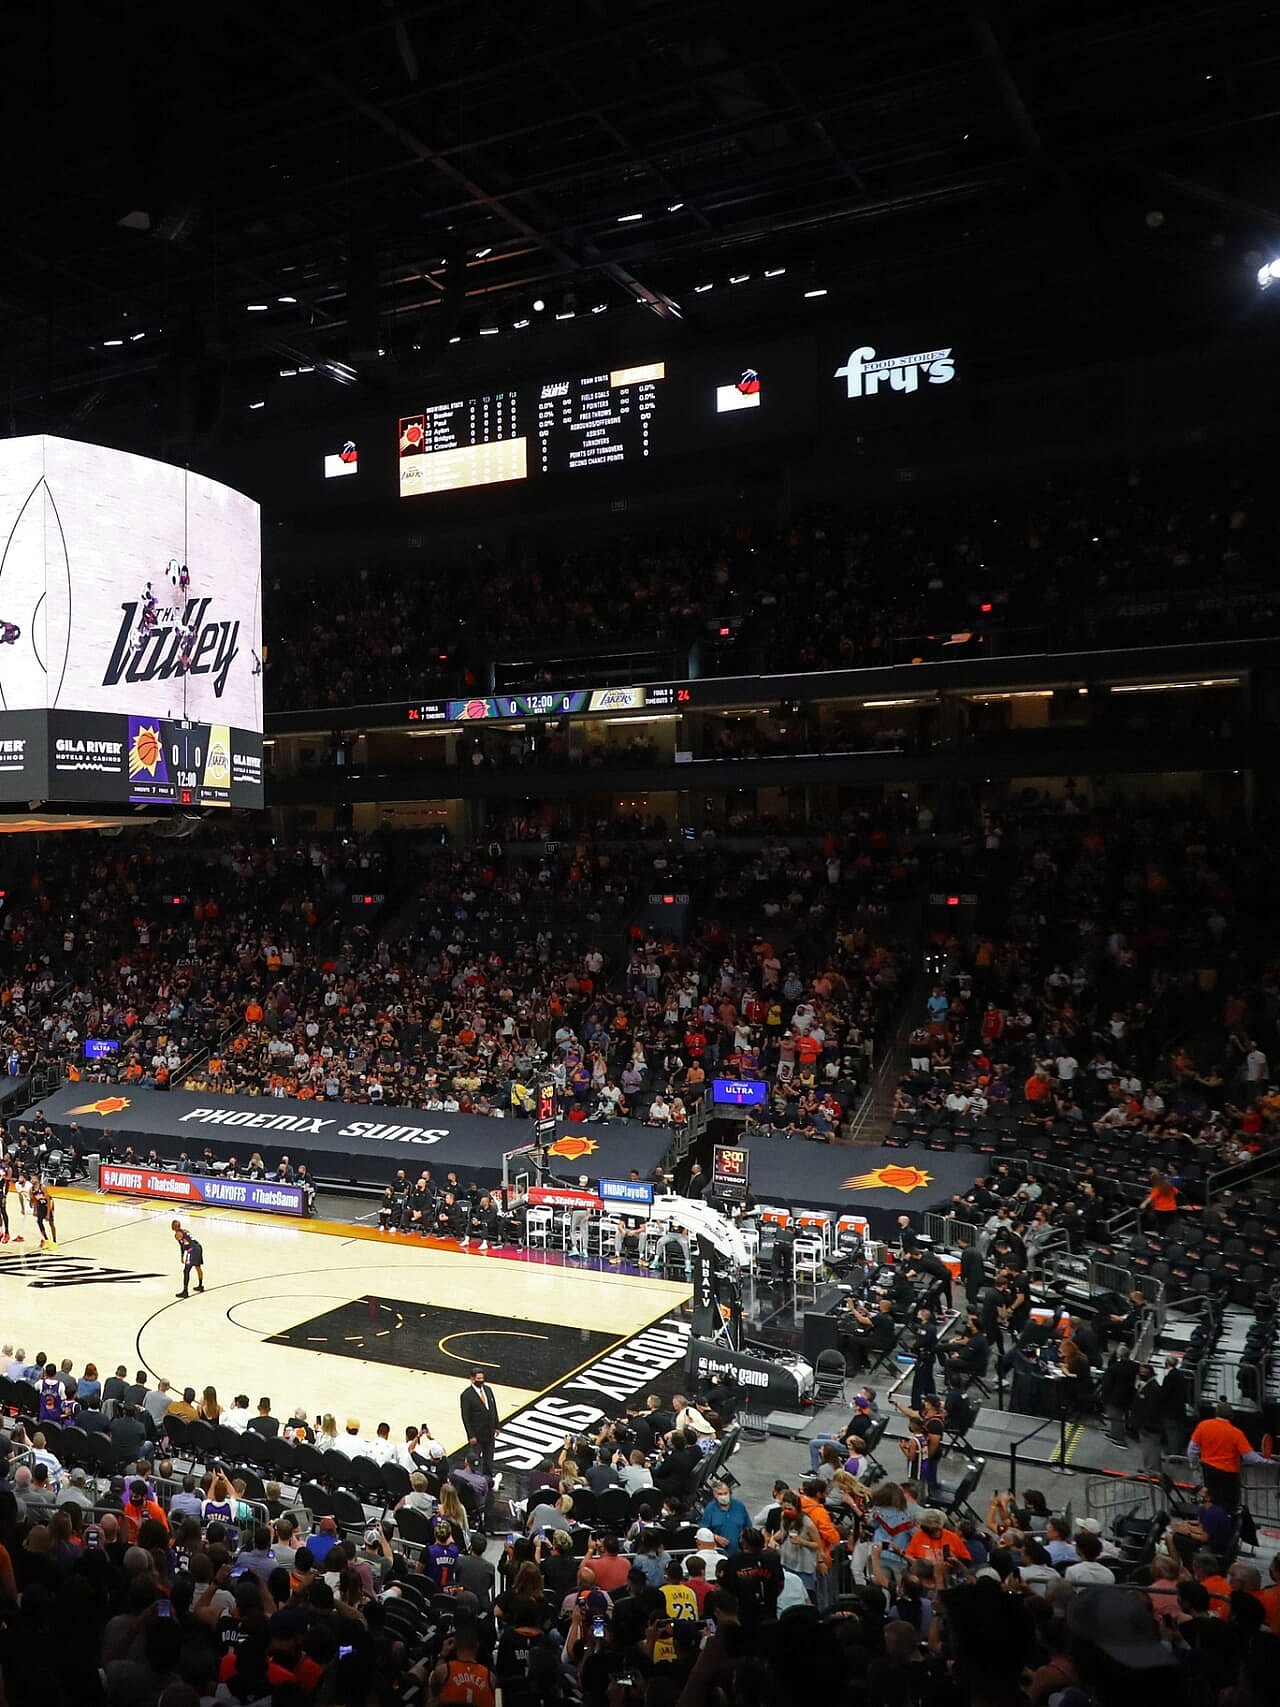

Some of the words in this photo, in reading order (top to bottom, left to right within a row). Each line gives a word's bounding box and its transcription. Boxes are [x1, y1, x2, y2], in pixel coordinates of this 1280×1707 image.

[864, 359, 895, 370] FOOD
[900, 350, 946, 364] STORES
[834, 346, 955, 398] fry's
[527, 696, 552, 708] 12:00
[600, 692, 633, 706] LAKERS
[678, 690, 690, 700] 24
[510, 701, 516, 713] 0
[563, 697, 569, 709] 0
[409, 710, 419, 719] 24
[56, 739, 85, 752] GILA
[87, 741, 120, 754] RIVER
[172, 745, 179, 765] 0
[195, 747, 201, 767] 0
[177, 772, 197, 787] 12:00
[726, 1087, 753, 1095] ULTRA
[541, 1100, 552, 1119] 24
[178, 1108, 336, 1134] PHOENIX
[338, 1122, 450, 1145] SUNS
[722, 1151, 744, 1162] 12:00
[723, 1162, 740, 1172] 24
[111, 1173, 142, 1189] PLAYOFFS
[148, 1176, 190, 1194] #ThatsGame
[212, 1185, 246, 1202] PLAYOFFS
[252, 1189, 299, 1208] #ThatsGame
[604, 1184, 648, 1199] #NBAPlayoffs
[555, 1196, 574, 1205] State
[575, 1197, 596, 1207] Farm
[702, 1259, 710, 1286] NBA
[702, 1289, 710, 1308] TV
[562, 1318, 692, 1402] PHOENIX
[738, 1369, 769, 1387] game
[46, 1396, 55, 1410] 3
[494, 1397, 605, 1470] SUNS
[441, 1567, 448, 1584] 1
[673, 1603, 696, 1621] 23
[467, 1688, 473, 1703] 1
